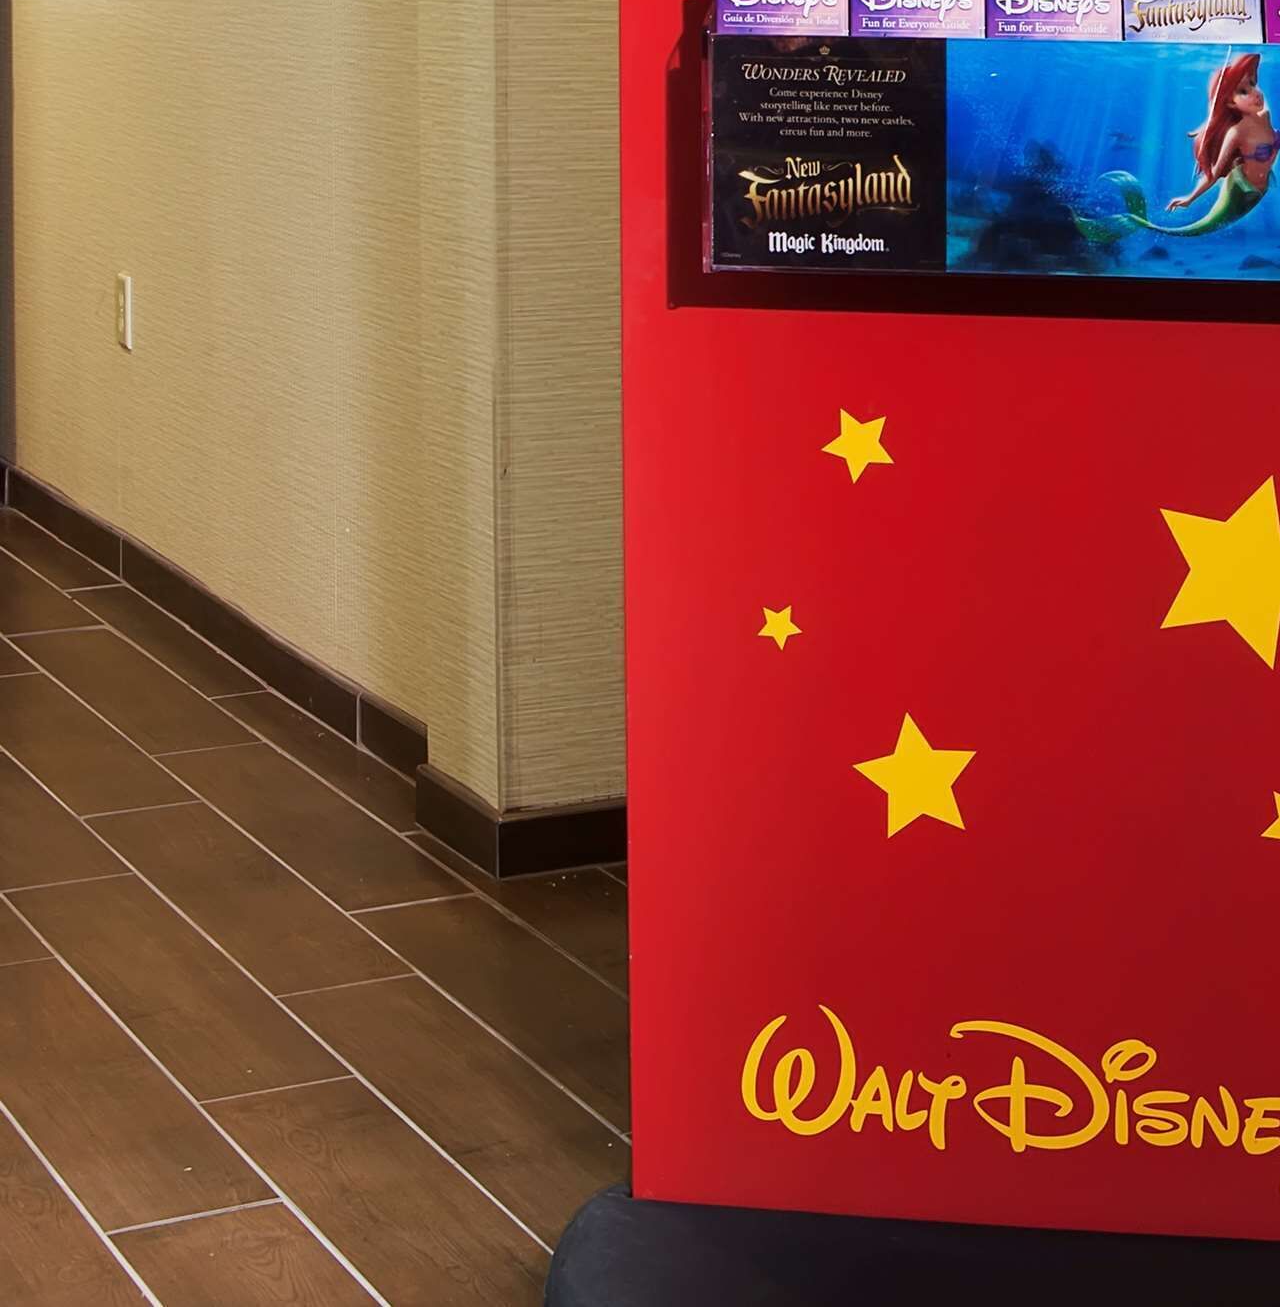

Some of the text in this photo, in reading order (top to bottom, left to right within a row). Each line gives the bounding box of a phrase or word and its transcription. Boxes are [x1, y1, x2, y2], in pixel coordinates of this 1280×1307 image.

[744, 14, 755, 22] de
[862, 17, 970, 31] Fun for Everyone Guide
[998, 22, 1017, 32] Fun
[1019, 22, 1033, 32] for
[1035, 22, 1077, 35] Everyone
[769, 87, 884, 101] Come experience Disney
[760, 101, 893, 113] storytelling like never before.
[739, 112, 915, 126] With new attractions, two new castles,
[809, 127, 825, 137] fun
[826, 128, 844, 137] and
[846, 130, 873, 138] more.
[785, 156, 821, 179] New
[738, 154, 912, 229] Fantasyland
[768, 231, 815, 254] Magic
[741, 1004, 967, 1150] Walt
